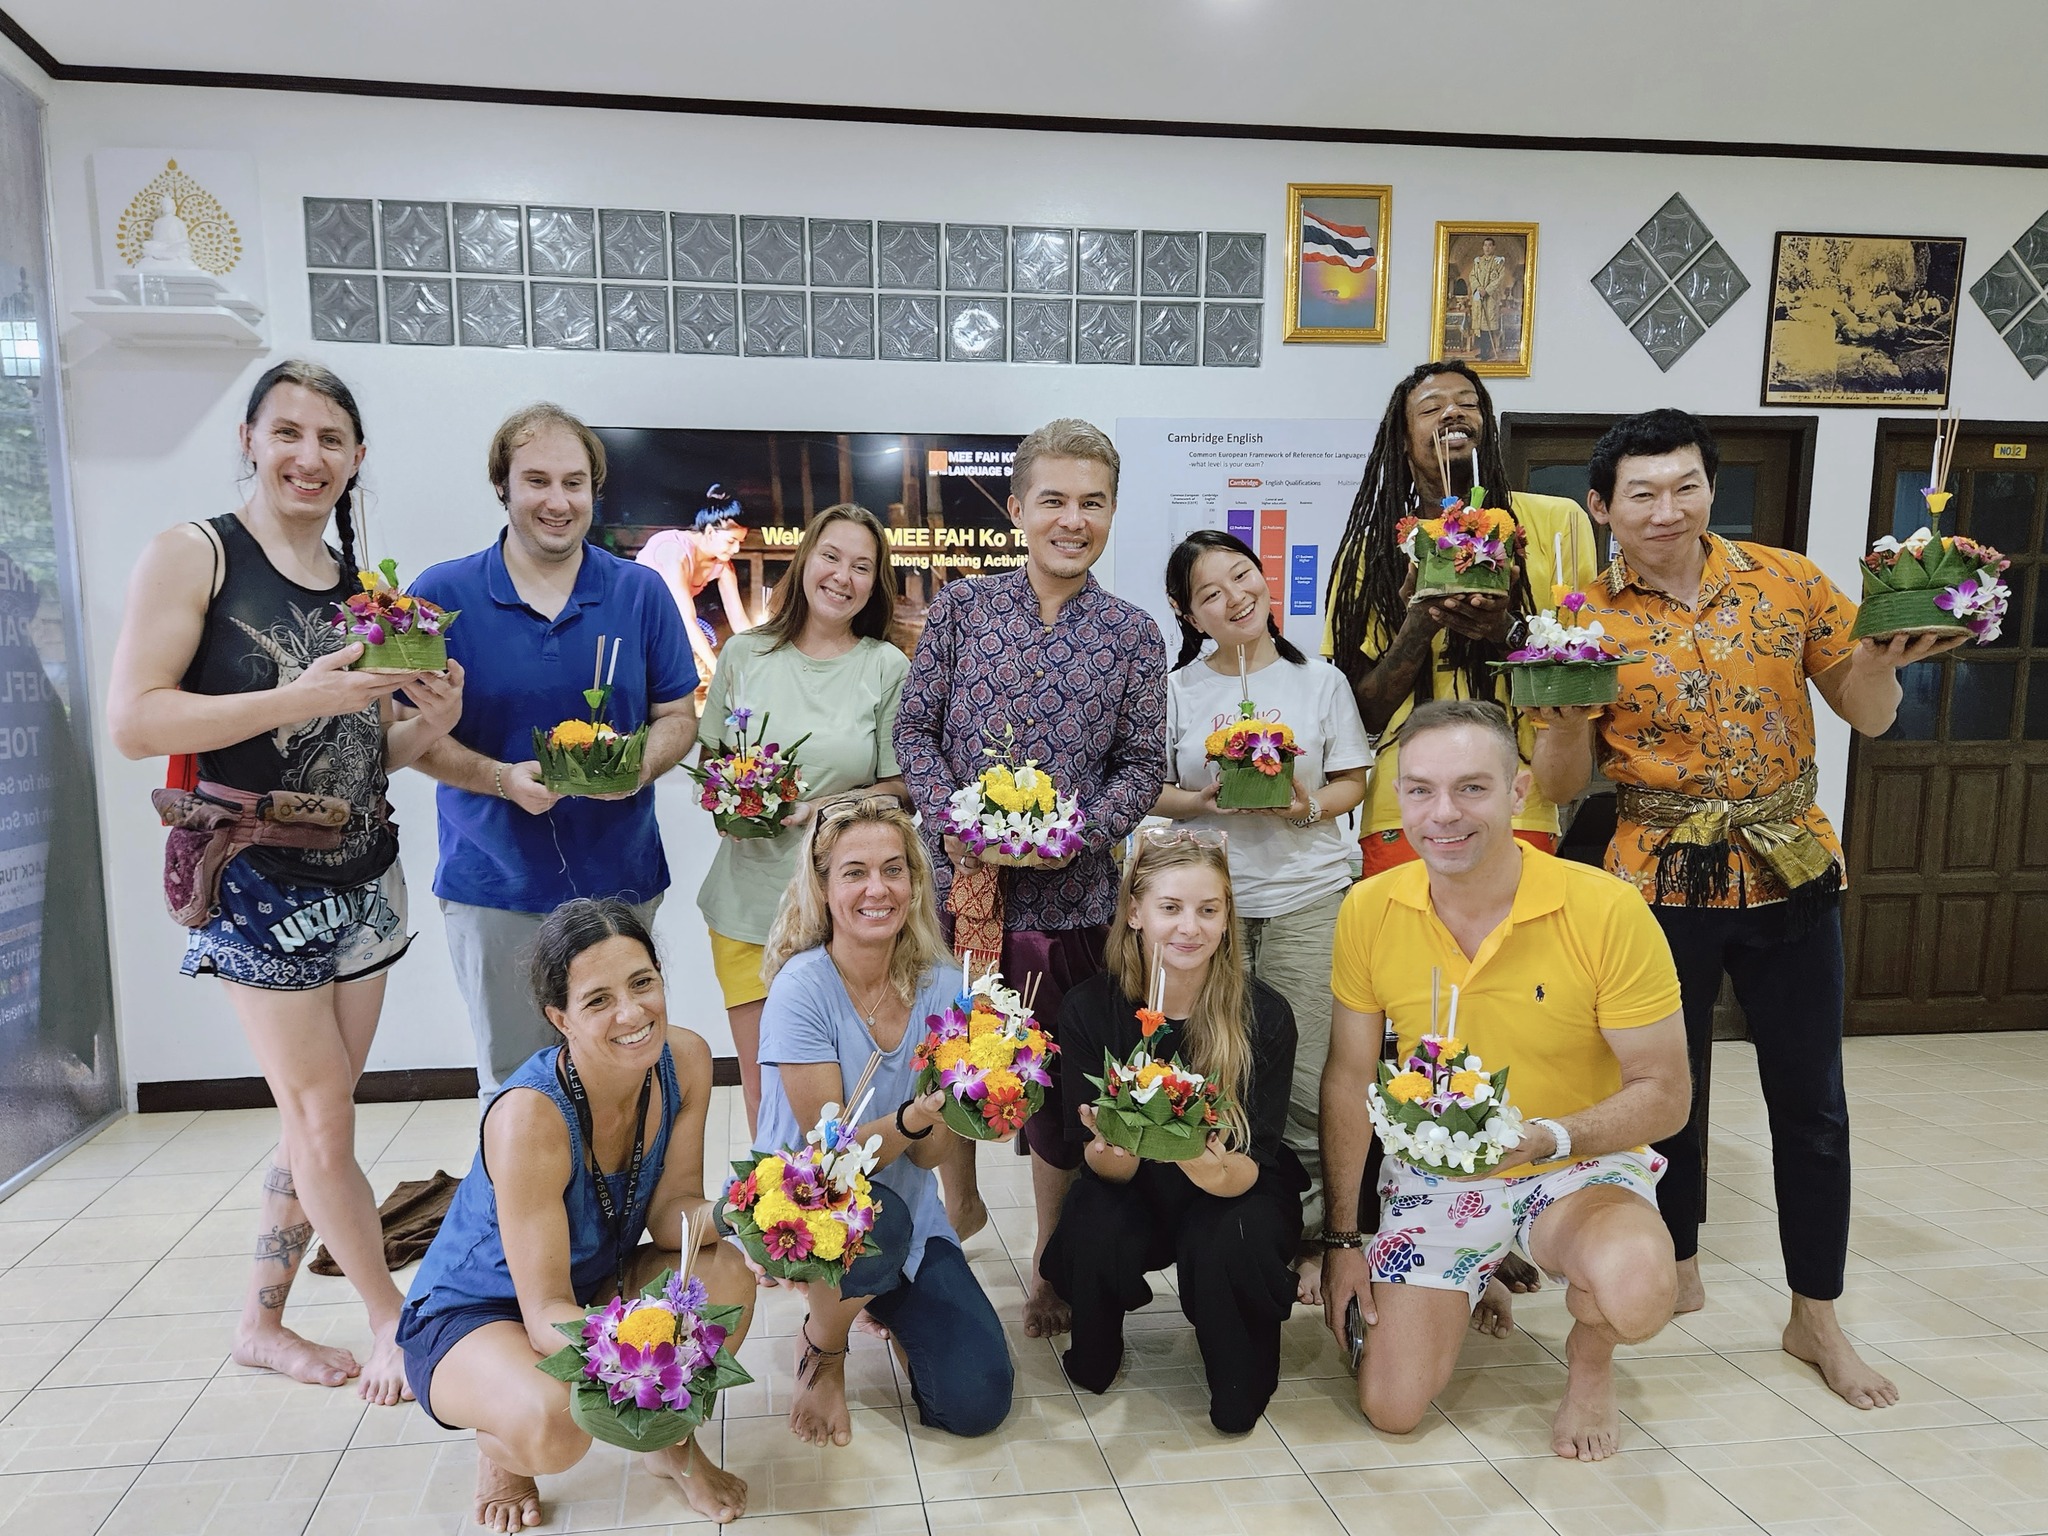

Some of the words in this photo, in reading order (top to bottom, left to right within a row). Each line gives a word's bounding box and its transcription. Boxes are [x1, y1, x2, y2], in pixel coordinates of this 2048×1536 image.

[1167, 433, 1224, 445] Cambridge
[1227, 433, 1264, 445] English
[948, 451, 973, 463] MEE
[974, 451, 999, 463] FAH
[1218, 451, 1248, 459] European
[1335, 452, 1367, 460] Languages
[948, 465, 1003, 477] LANGUAGE
[1229, 479, 1259, 487] Cambridge
[884, 527, 930, 547] MEE
[934, 528, 975, 547] FAH
[979, 528, 1007, 548] Ko
[932, 554, 981, 569] Making
